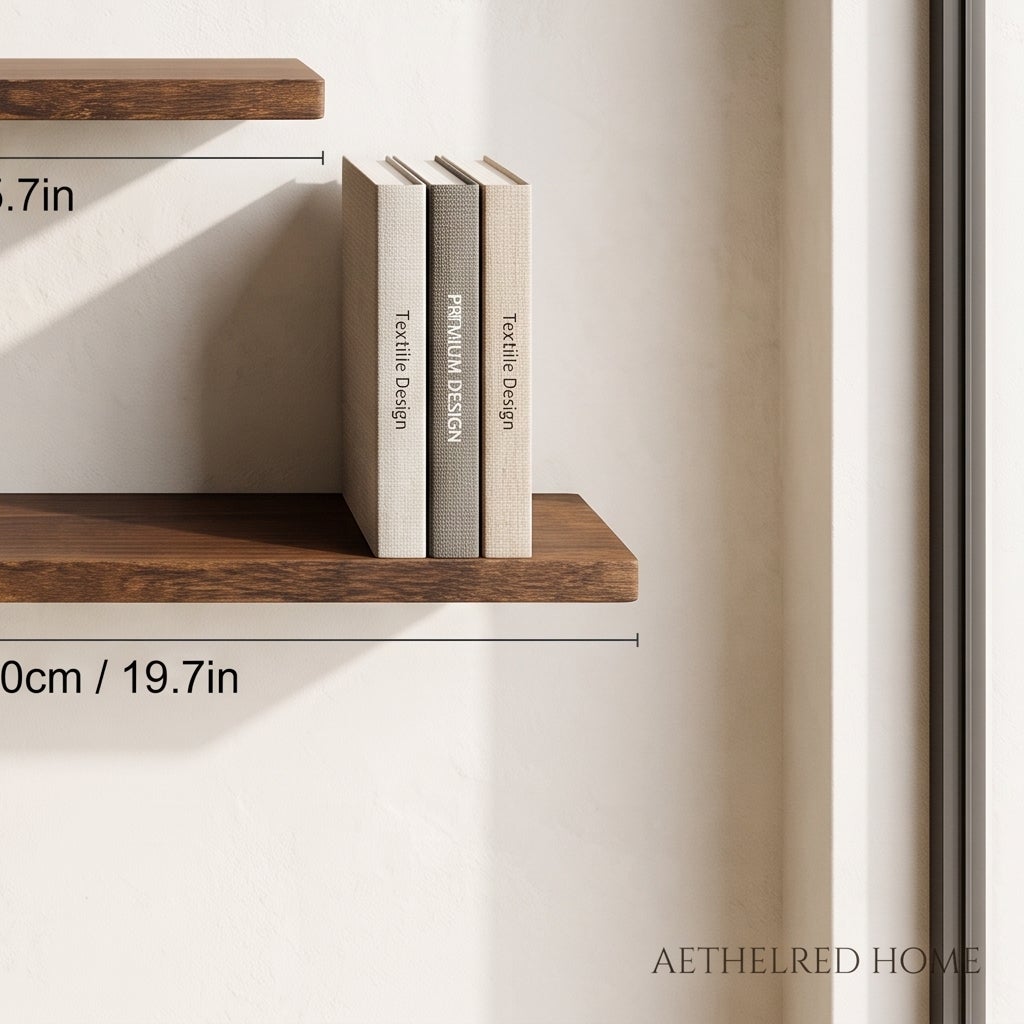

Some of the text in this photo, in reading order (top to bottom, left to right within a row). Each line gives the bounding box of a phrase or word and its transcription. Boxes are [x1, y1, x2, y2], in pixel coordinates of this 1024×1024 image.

[391, 377, 410, 430] Design
[447, 379, 463, 443] DESIGN
[498, 378, 517, 430] Design
